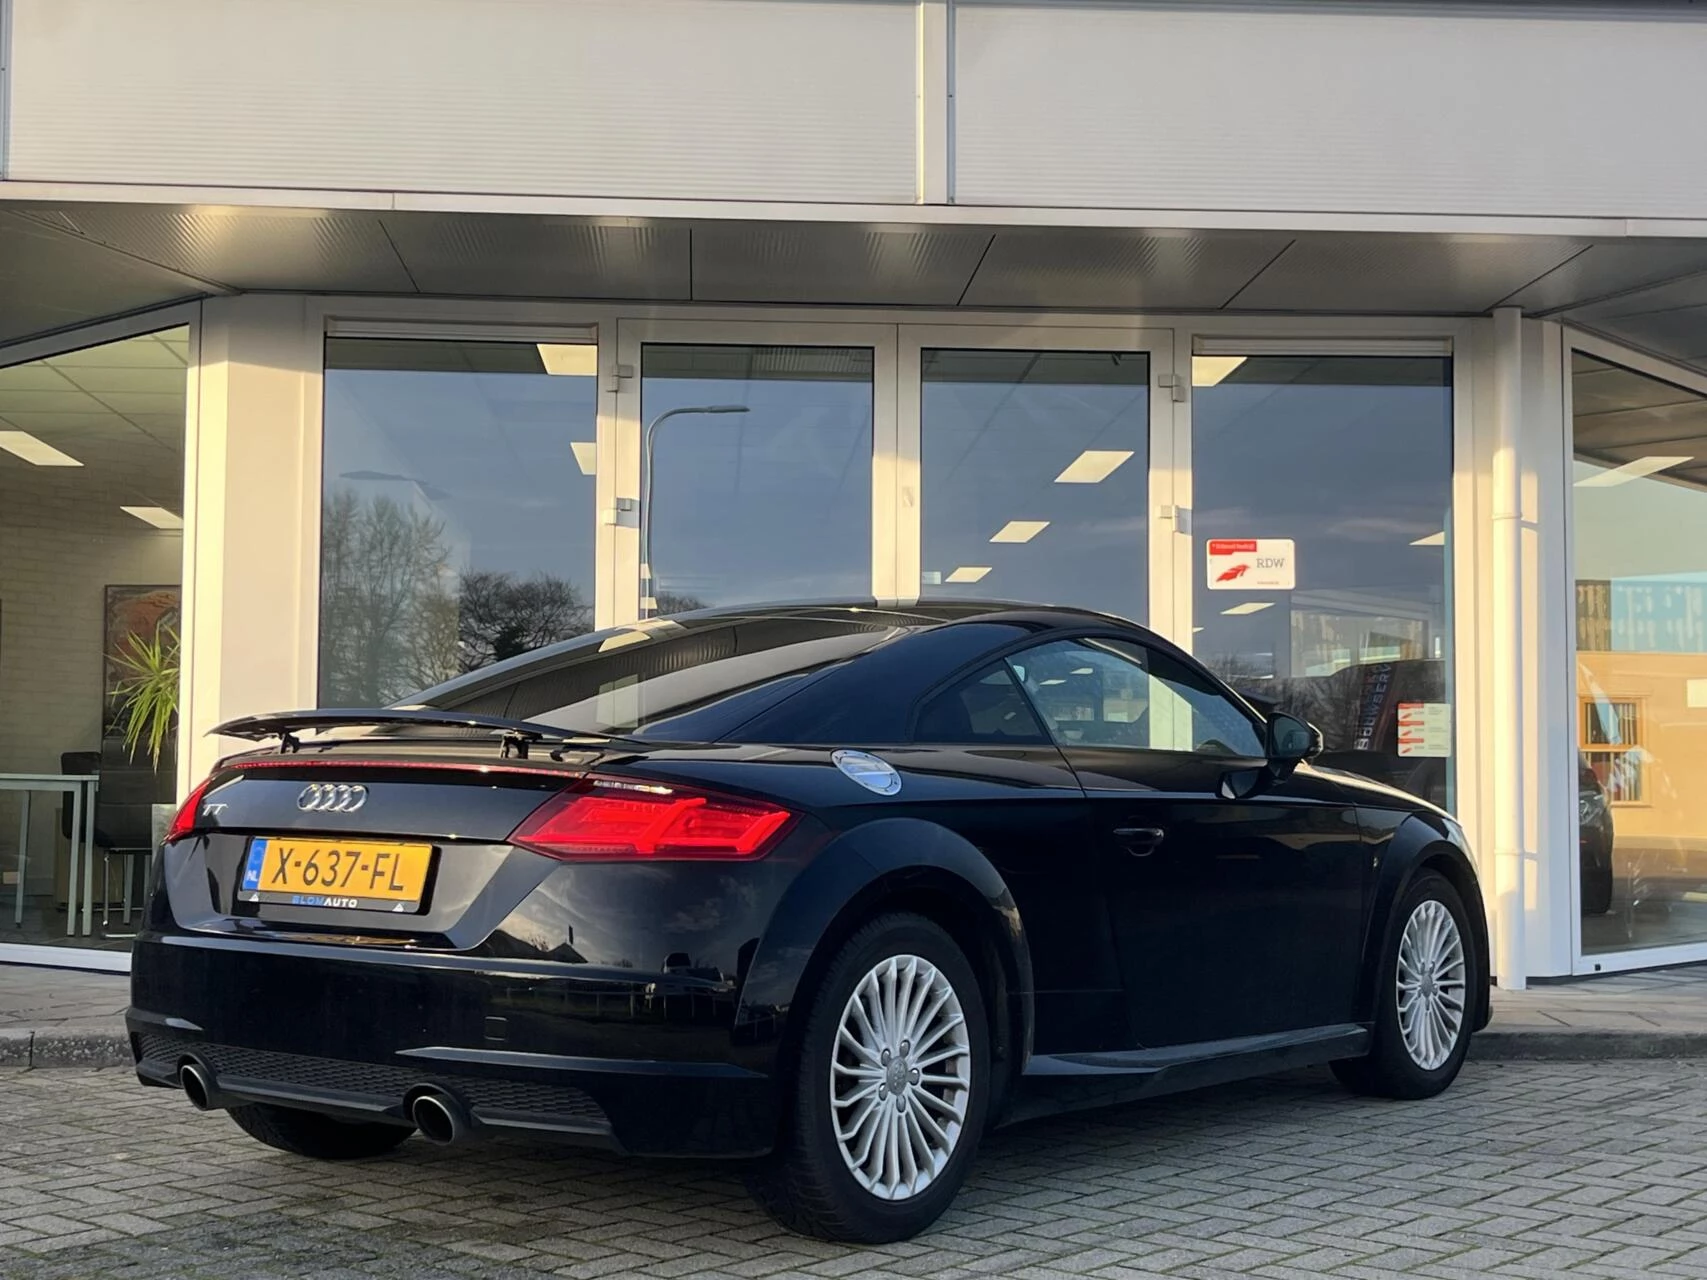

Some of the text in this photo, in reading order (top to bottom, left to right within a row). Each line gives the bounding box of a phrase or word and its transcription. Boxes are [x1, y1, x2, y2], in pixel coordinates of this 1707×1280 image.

[1256, 558, 1285, 569] RDW
[203, 803, 229, 816] TT
[271, 847, 404, 892] X-637-FL
[246, 870, 258, 882] NL
